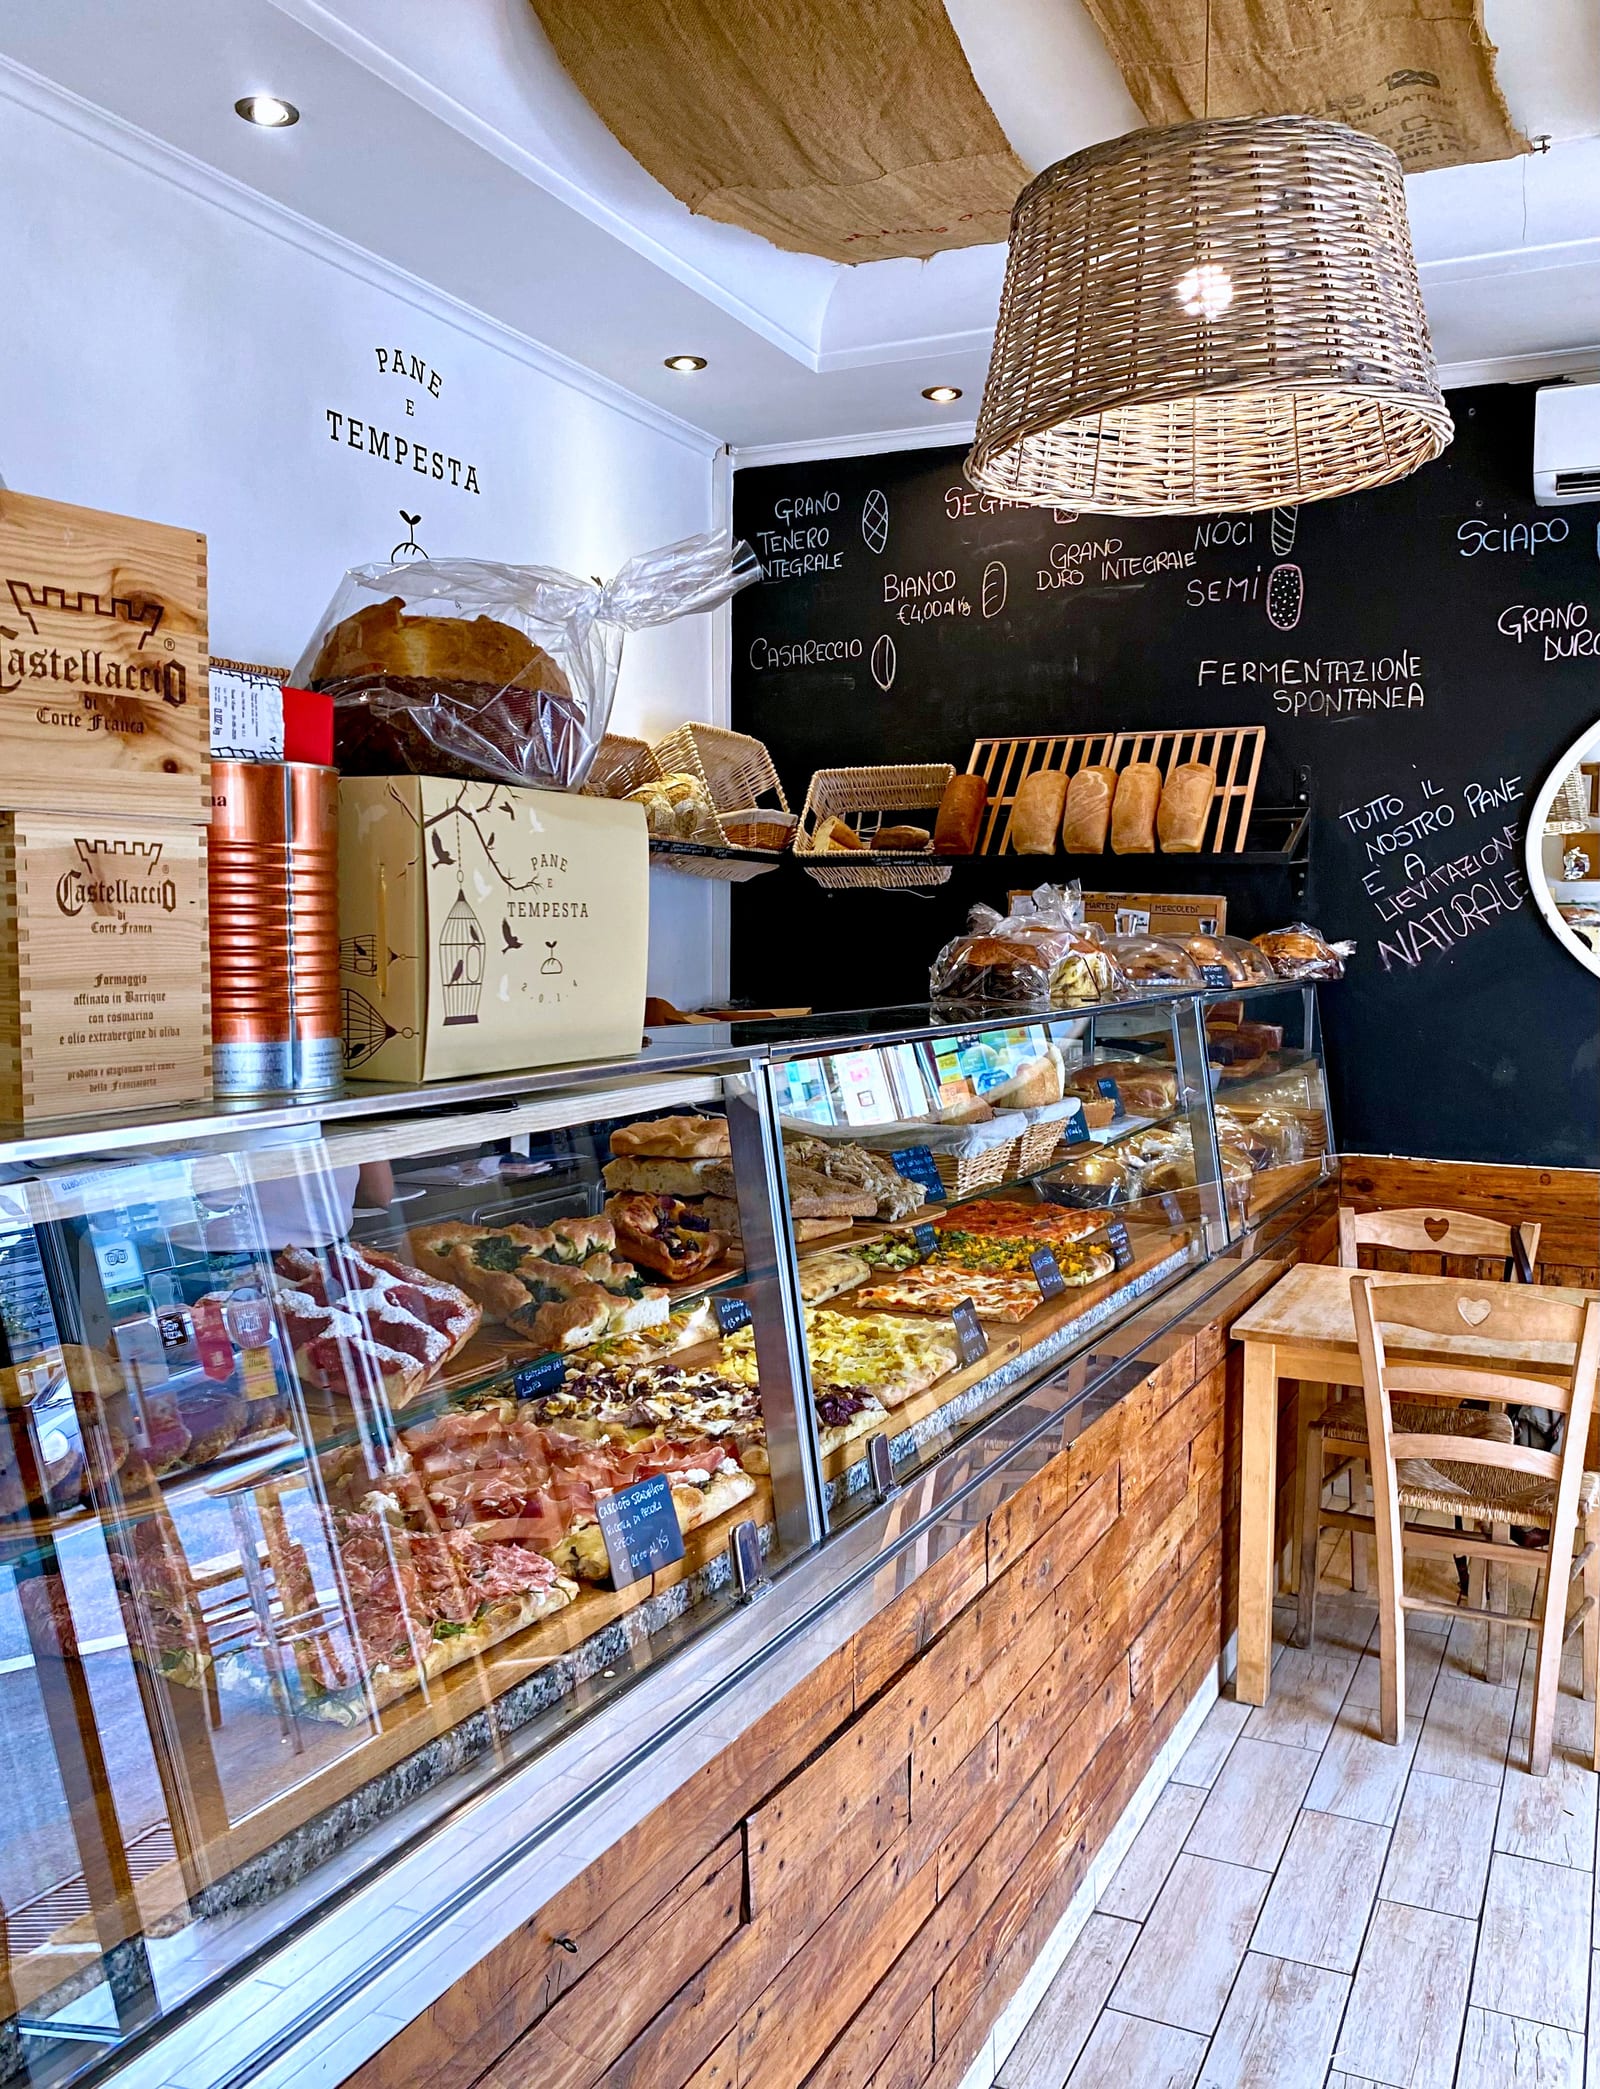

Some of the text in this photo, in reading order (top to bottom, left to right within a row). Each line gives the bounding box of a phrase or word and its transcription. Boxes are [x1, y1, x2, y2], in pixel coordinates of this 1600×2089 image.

[375, 347, 443, 399] PANE
[405, 398, 415, 417] E
[326, 408, 481, 495] TEMPESTA
[774, 490, 840, 527] GRANO
[756, 528, 830, 556] TENERO
[1049, 538, 1123, 569] GRANO
[760, 551, 844, 581] NTEGRALE
[1036, 568, 1084, 591] DURO
[883, 569, 956, 602] BIANCO
[1186, 565, 1262, 607] SEMI
[1497, 602, 1588, 643] GRANO
[749, 637, 863, 670] CASARECCIO
[1198, 648, 1422, 687] FERMENTAZIONE
[1272, 682, 1425, 717] SPONTANEA
[36, 707, 144, 735] Corte Franca
[1338, 779, 1444, 835] TUTTO IL
[1365, 776, 1525, 862] NOSTRO PANE
[531, 853, 568, 874] PANE
[1374, 821, 1523, 922] LIEVITAZIONE
[1404, 852, 1427, 881] A
[547, 877, 553, 888] E
[507, 901, 589, 919] TEMPESTA
[1377, 869, 1529, 973] NATURALE
[91, 921, 153, 936] Corte Franca
[93, 973, 147, 988] Formaggio
[73, 993, 110, 1006] affinato
[112, 992, 122, 1004] in
[88, 1011, 154, 1024] con rosmarino
[59, 1035, 65, 1045] e
[67, 1032, 86, 1045] olio
[88, 1029, 146, 1042] extravergine
[159, 1026, 180, 1037] oliva
